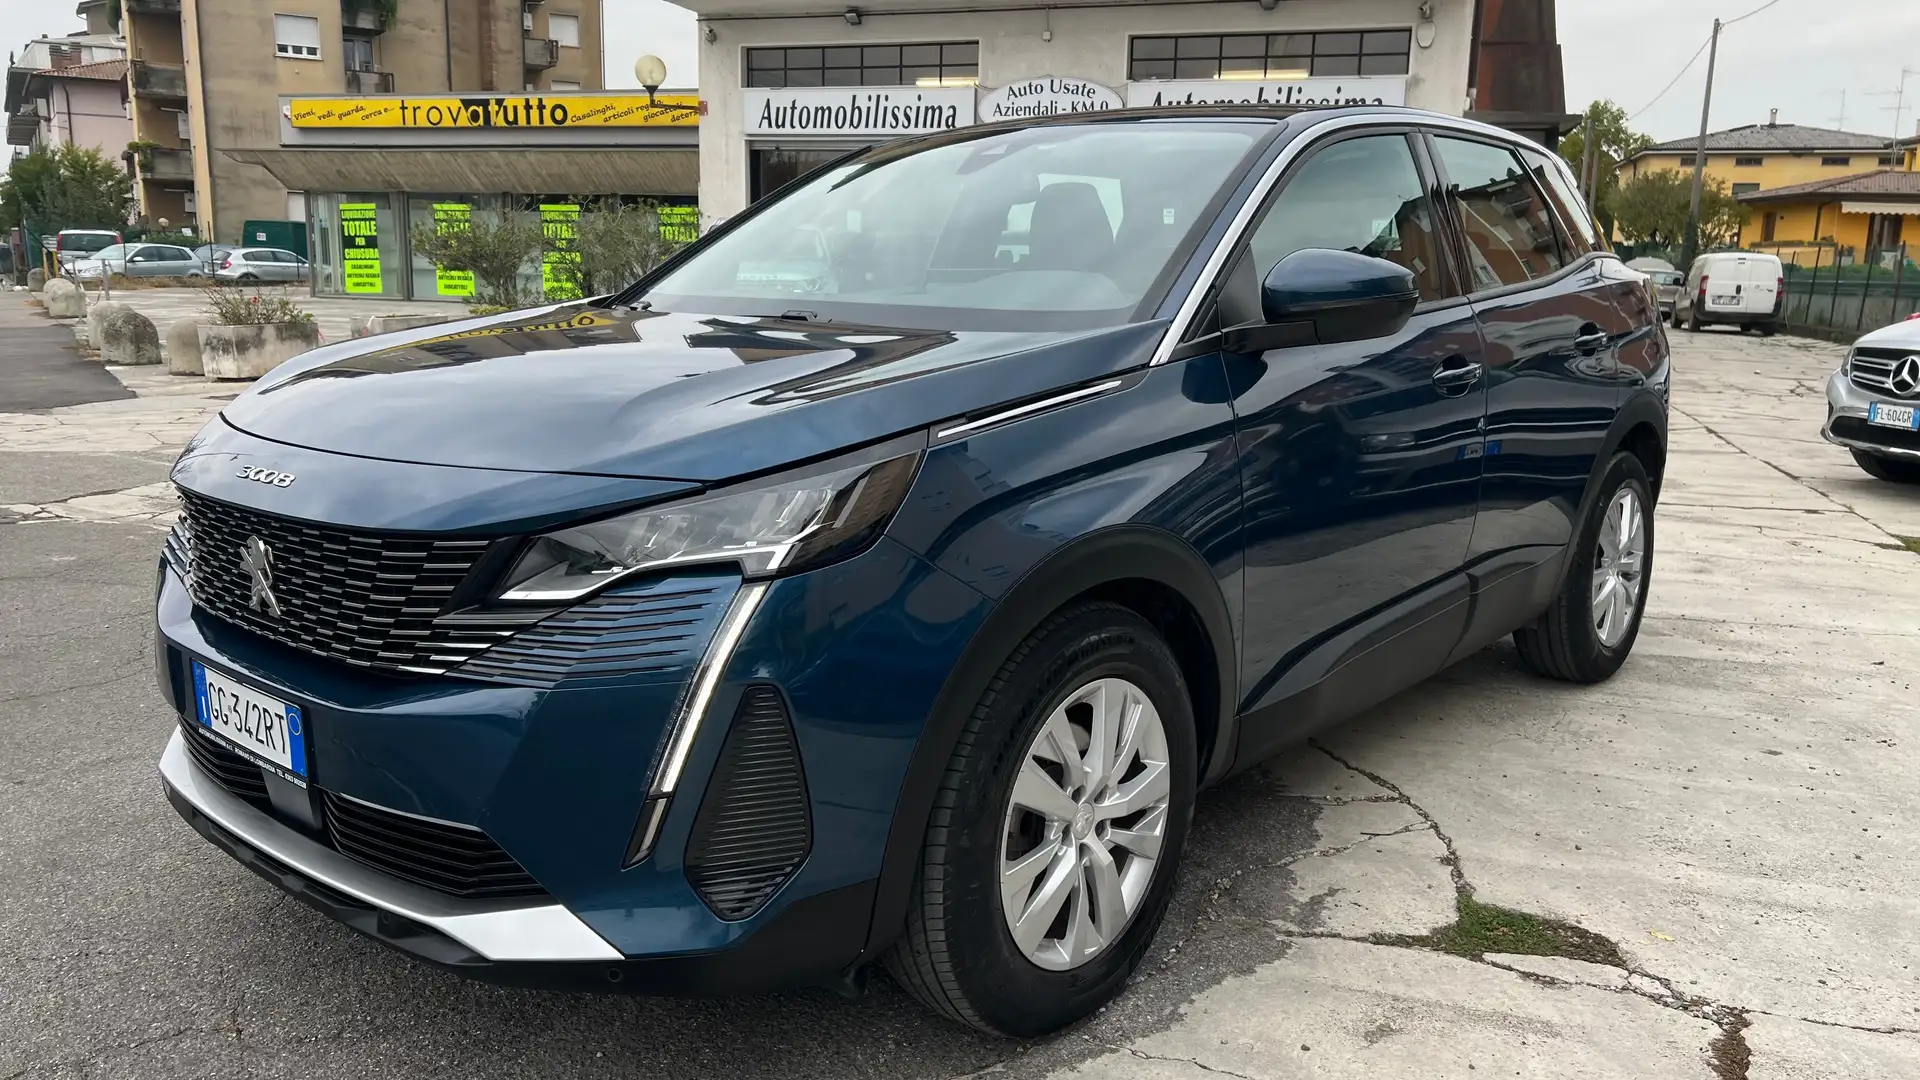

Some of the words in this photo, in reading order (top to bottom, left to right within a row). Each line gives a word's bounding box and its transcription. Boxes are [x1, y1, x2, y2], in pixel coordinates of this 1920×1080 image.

[1007, 82, 1044, 101] Auto
[1050, 79, 1096, 99] Usate
[294, 108, 316, 120] Vieni,
[317, 110, 336, 121] vedi,
[337, 104, 366, 121] guarda,
[361, 109, 382, 121] cerca
[400, 98, 568, 127] trovatutto
[570, 103, 616, 123] Casalinghi,
[603, 107, 634, 123] articoli
[758, 94, 957, 130] Automobilissima
[993, 100, 1058, 117] Aziendali
[342, 221, 378, 236] TOTALE
[355, 237, 366, 246] PER
[344, 248, 380, 259] CHIUSURA
[236, 464, 297, 488] 3008
